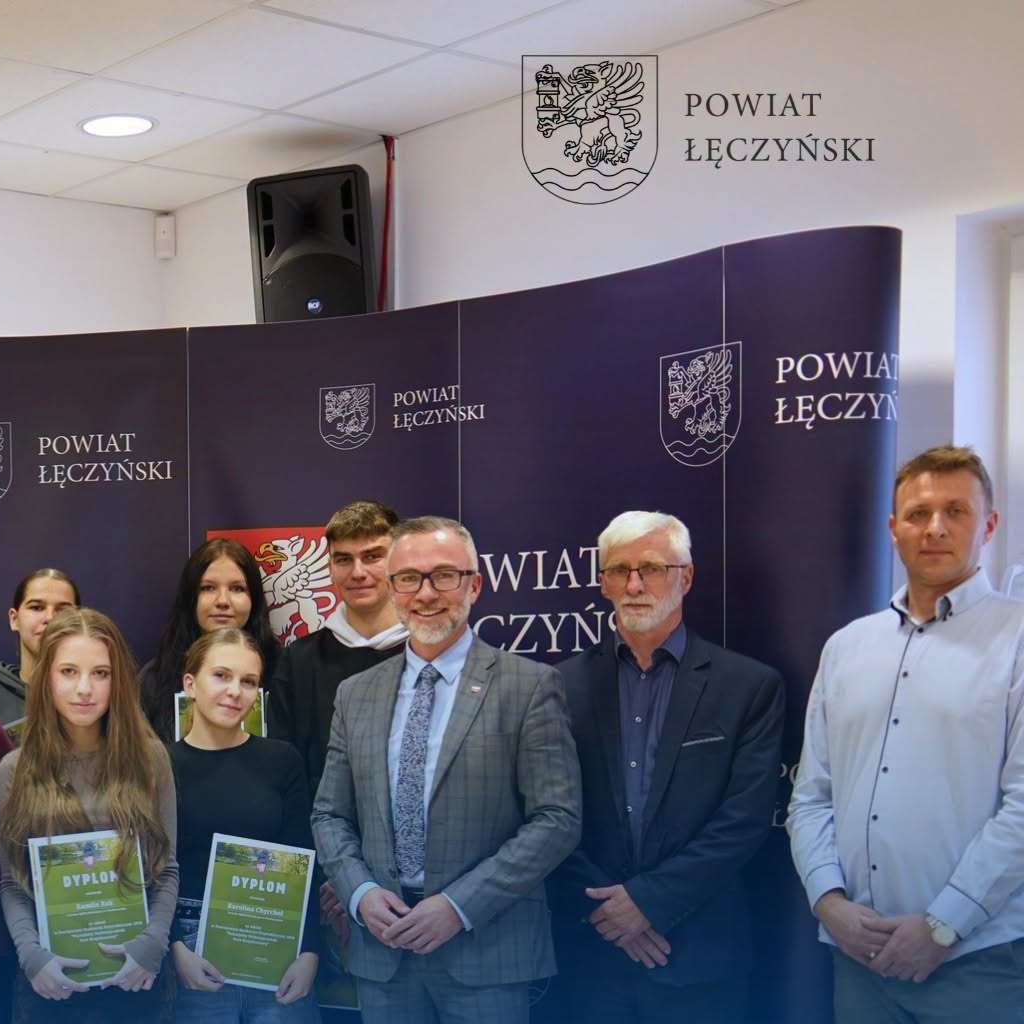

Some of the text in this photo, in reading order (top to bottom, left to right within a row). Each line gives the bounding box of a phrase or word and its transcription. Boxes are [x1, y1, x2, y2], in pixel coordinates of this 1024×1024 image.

[392, 384, 461, 409] POWIAT
[392, 402, 486, 431] ŁĘCZYŃSKI
[37, 432, 136, 456] POWIAT
[37, 457, 174, 489] ŁĘCZYŃSKI
[479, 546, 601, 593] WIAT
[231, 875, 287, 895] DYPLOM
